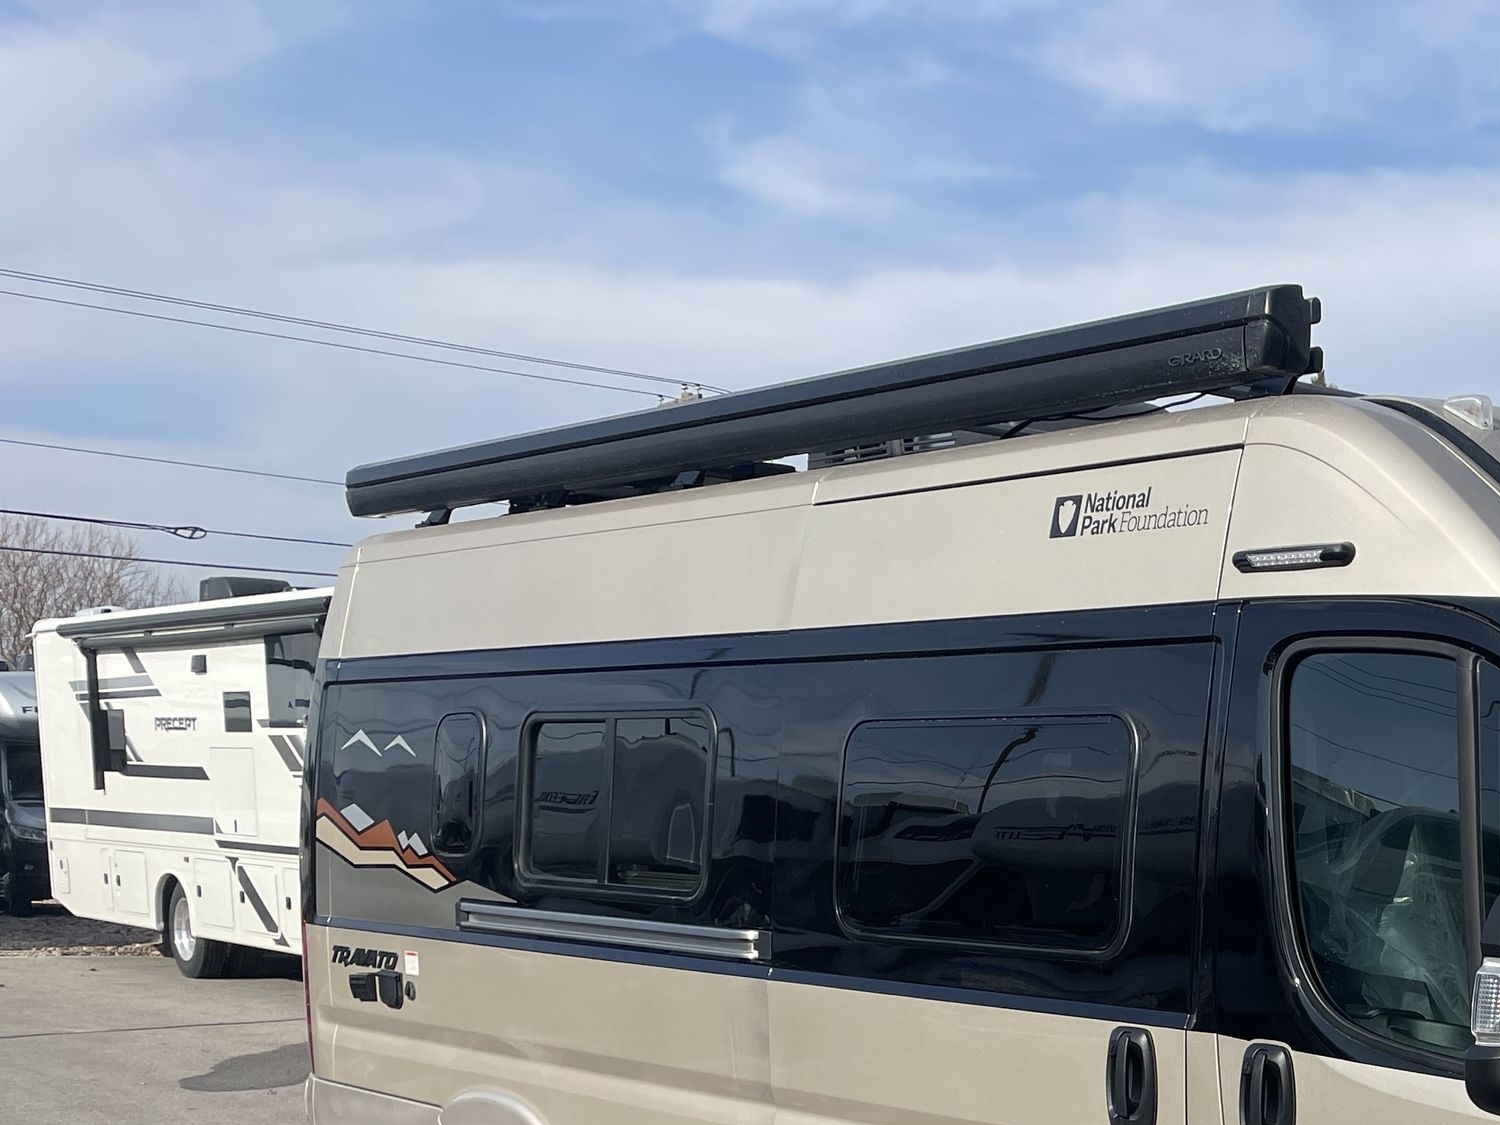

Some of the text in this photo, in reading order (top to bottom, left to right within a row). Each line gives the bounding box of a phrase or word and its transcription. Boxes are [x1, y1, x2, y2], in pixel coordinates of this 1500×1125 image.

[1084, 487, 1152, 513] National
[1080, 505, 1208, 536] Park Foundation
[154, 716, 197, 732] PRECEPT
[332, 945, 398, 970] TRAVATO
